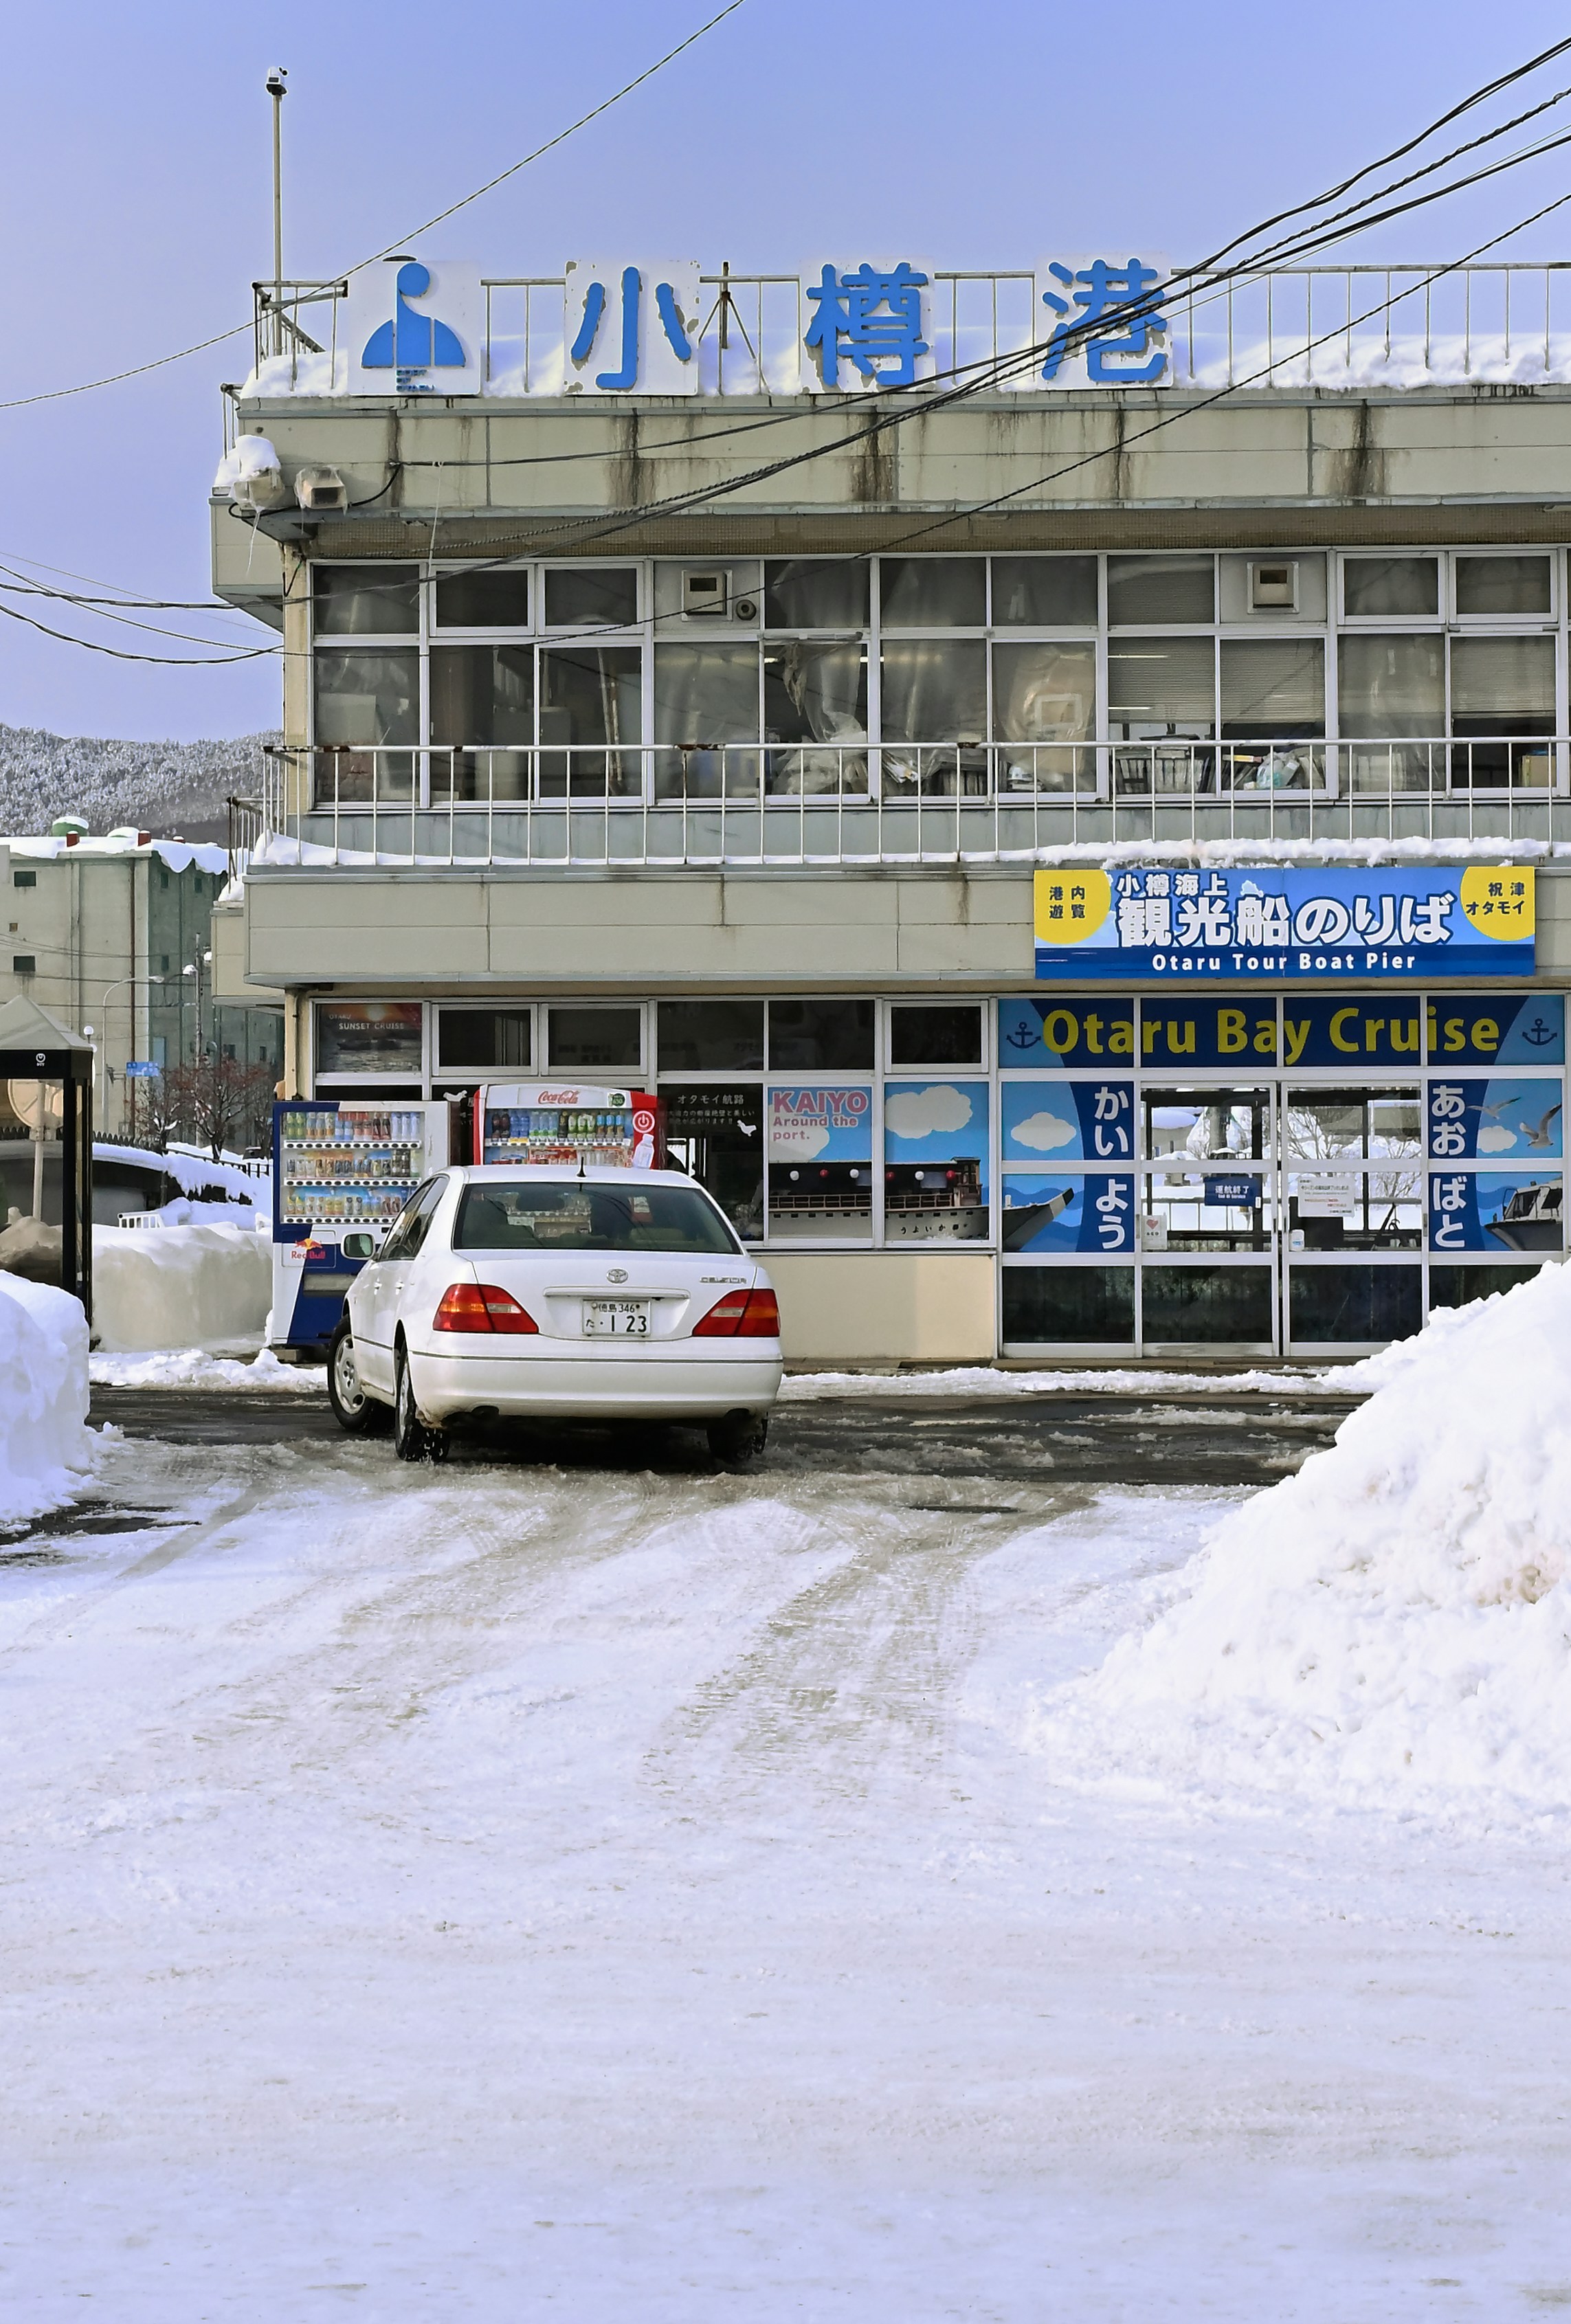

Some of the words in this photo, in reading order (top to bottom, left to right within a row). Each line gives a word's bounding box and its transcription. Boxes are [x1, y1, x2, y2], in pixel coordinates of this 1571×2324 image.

[1117, 874, 1227, 896] 小樽海上
[1488, 882, 1525, 897] 祝津
[1049, 886, 1085, 900] 港内
[1049, 904, 1085, 919] 遊覧
[1466, 901, 1525, 915] オタモイ
[1118, 893, 1453, 947] 観光船のりば
[1152, 954, 1221, 970] Otaru
[1232, 953, 1286, 970] Tour
[1300, 953, 1354, 970] Boat
[1367, 952, 1415, 969] Pier
[1043, 1009, 1196, 1054] Otaru
[1217, 1009, 1311, 1066] Bay
[1329, 1005, 1500, 1052] Cruise
[678, 1095, 744, 1104] オタモイ航路
[773, 1091, 869, 1114] KAIYO
[773, 1116, 827, 1127] Around
[833, 1117, 858, 1127] the
[773, 1130, 810, 1141] port.
[291, 1251, 307, 1259] Red
[309, 1251, 326, 1259] Bull
